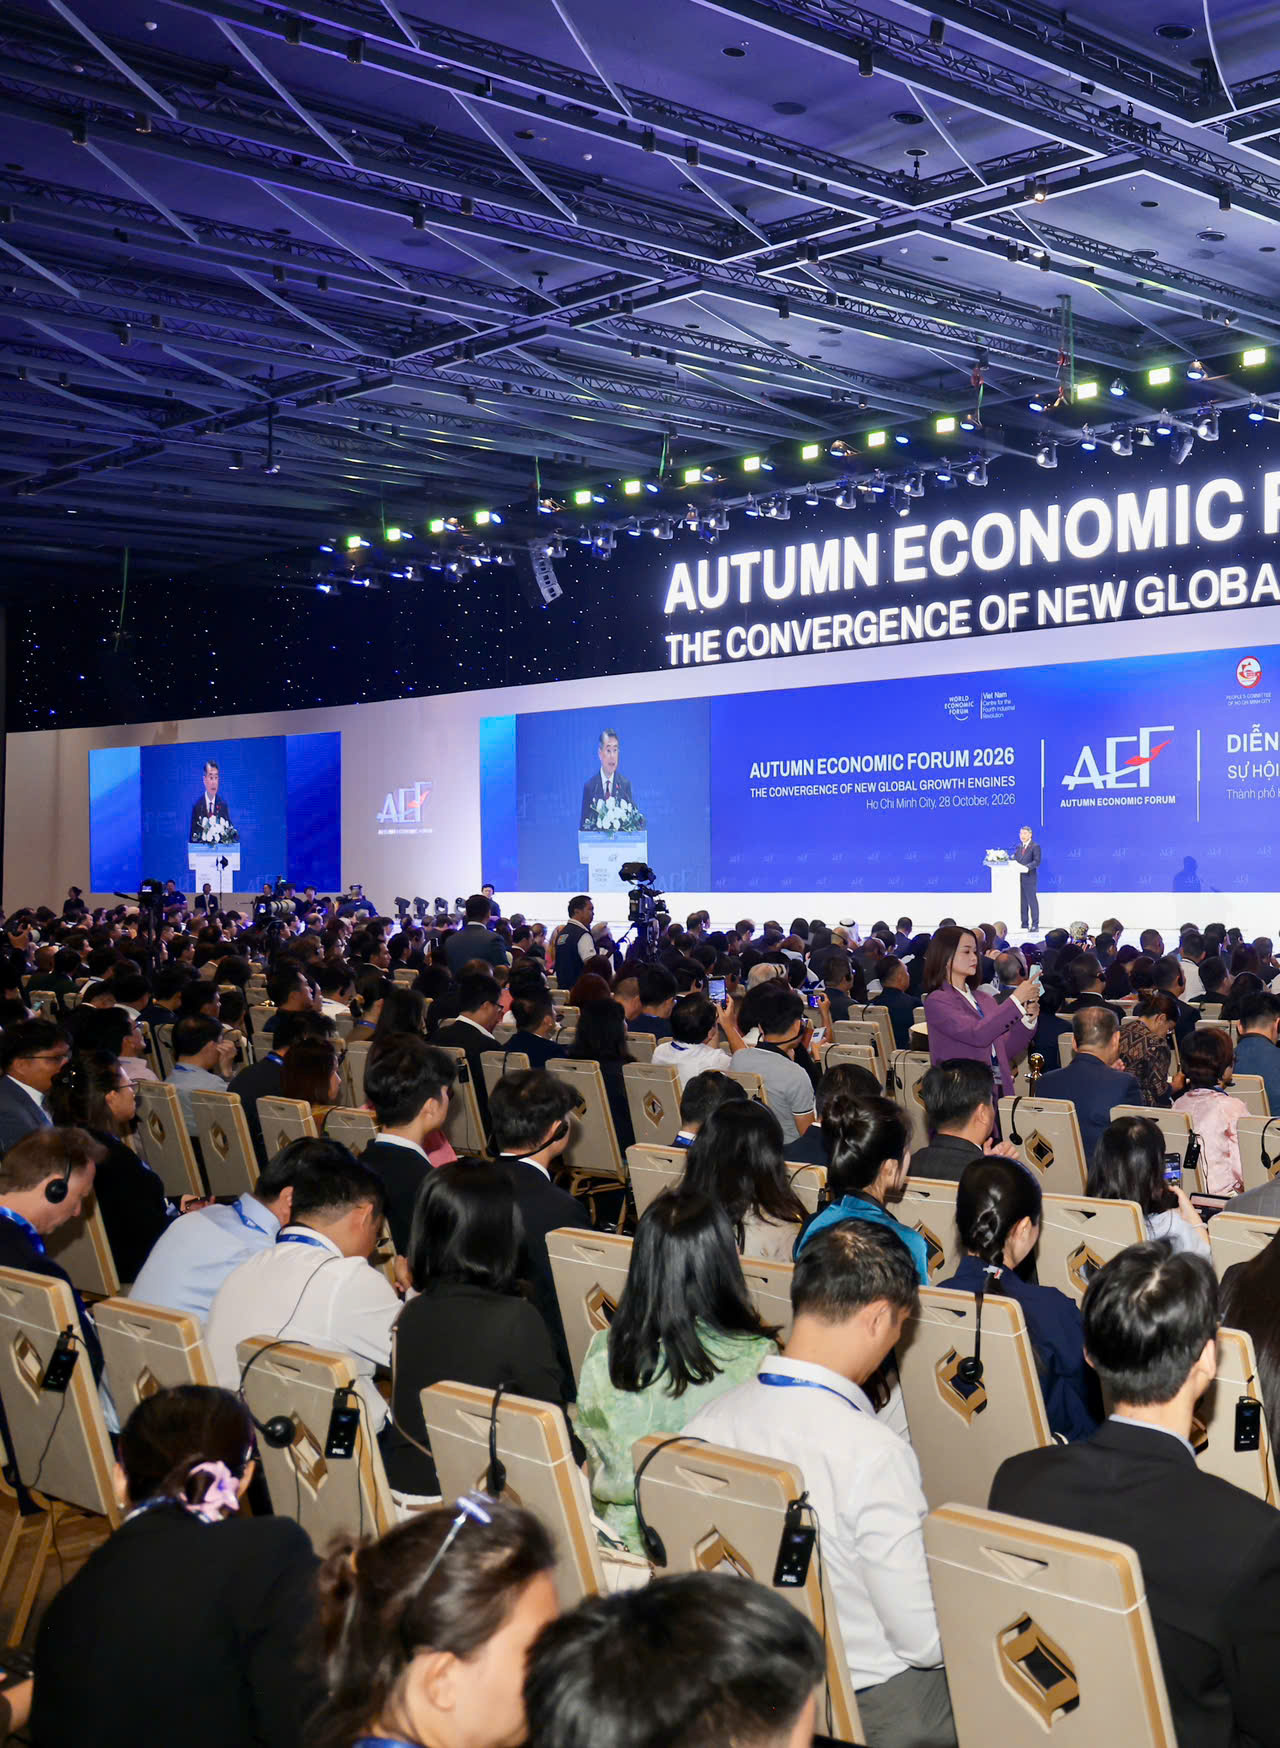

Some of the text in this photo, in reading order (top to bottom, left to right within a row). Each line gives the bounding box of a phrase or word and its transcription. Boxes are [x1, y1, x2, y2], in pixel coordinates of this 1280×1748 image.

[663, 532, 878, 614] AUTUMN
[893, 476, 1244, 582] ECONOMIC
[664, 628, 720, 665] THE
[726, 599, 971, 659] CONVERGENCE
[979, 592, 1030, 631] OF
[1037, 580, 1128, 625] NEW
[1227, 724, 1279, 753] DIỄN
[750, 747, 1015, 779] AUTUMN ECONOMIC FORUM 2026
[1061, 725, 1175, 791] AEF
[1227, 761, 1249, 782] SỰ
[1252, 761, 1280, 782] HỘI
[750, 775, 1016, 799] THE CONVERGENCE OF NEW GLOBAL GROWTH ENGINES
[1226, 788, 1256, 800] Thành
[1257, 786, 1276, 800] phố
[866, 793, 1016, 810] Ho Chi Minh City, 28 October, 2026
[1060, 795, 1176, 808] AUTUMN ECONOMIC FORUM
